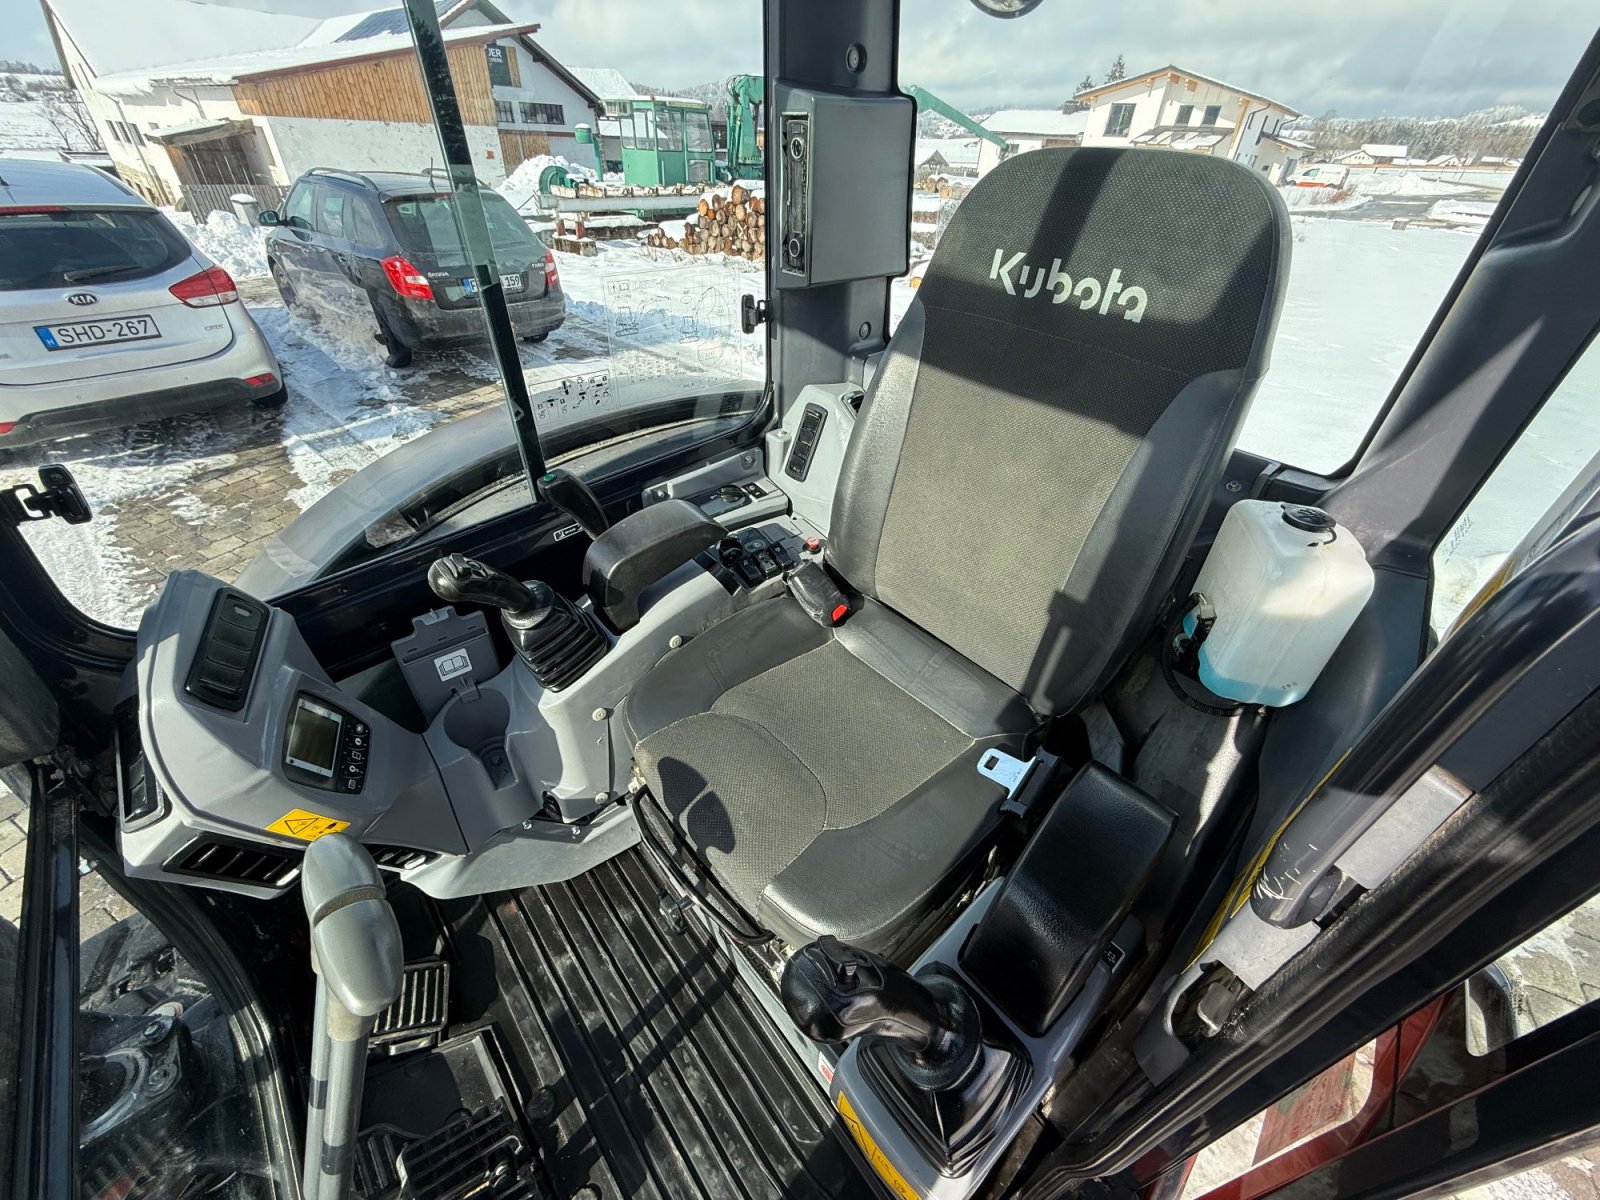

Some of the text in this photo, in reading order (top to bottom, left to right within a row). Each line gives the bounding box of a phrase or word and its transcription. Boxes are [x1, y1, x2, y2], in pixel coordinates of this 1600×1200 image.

[989, 248, 1148, 323] Kubota
[71, 295, 96, 304] KIA
[57, 319, 149, 344] SHD-267
